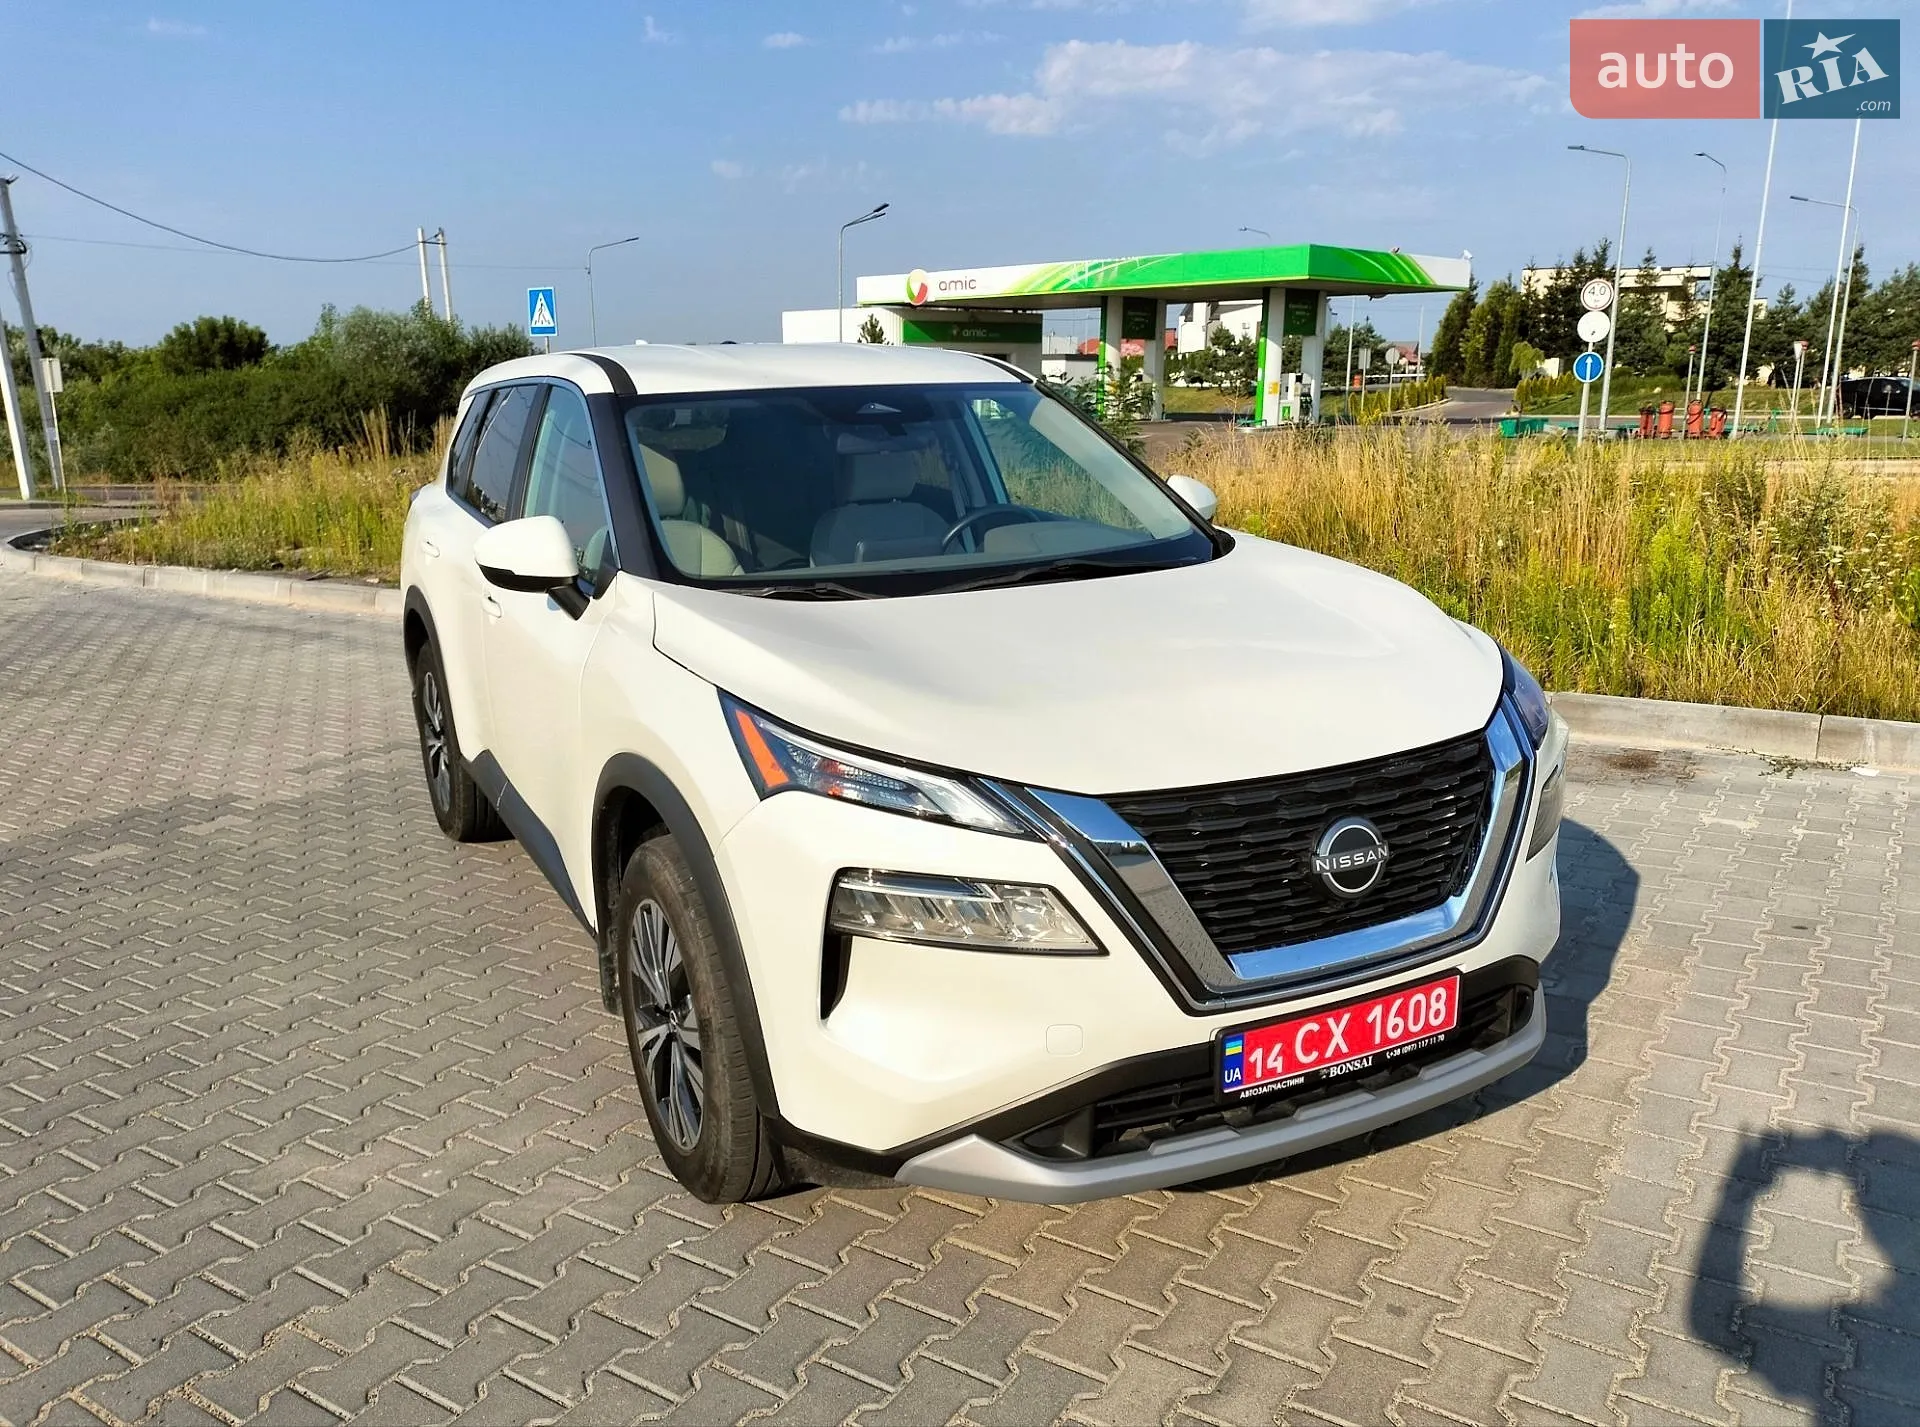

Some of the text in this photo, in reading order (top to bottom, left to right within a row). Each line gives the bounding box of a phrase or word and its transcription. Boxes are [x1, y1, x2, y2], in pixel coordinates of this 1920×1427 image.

[939, 276, 977, 290] amic
[962, 328, 988, 337] amic
[1315, 845, 1388, 872] NISSAN
[1248, 986, 1448, 1079] 14 CX 1608
[1224, 1067, 1242, 1083] UA
[1329, 1056, 1374, 1079] BONSAI
[1239, 1076, 1305, 1099] АВТОЗАПЧАСТИНИ
